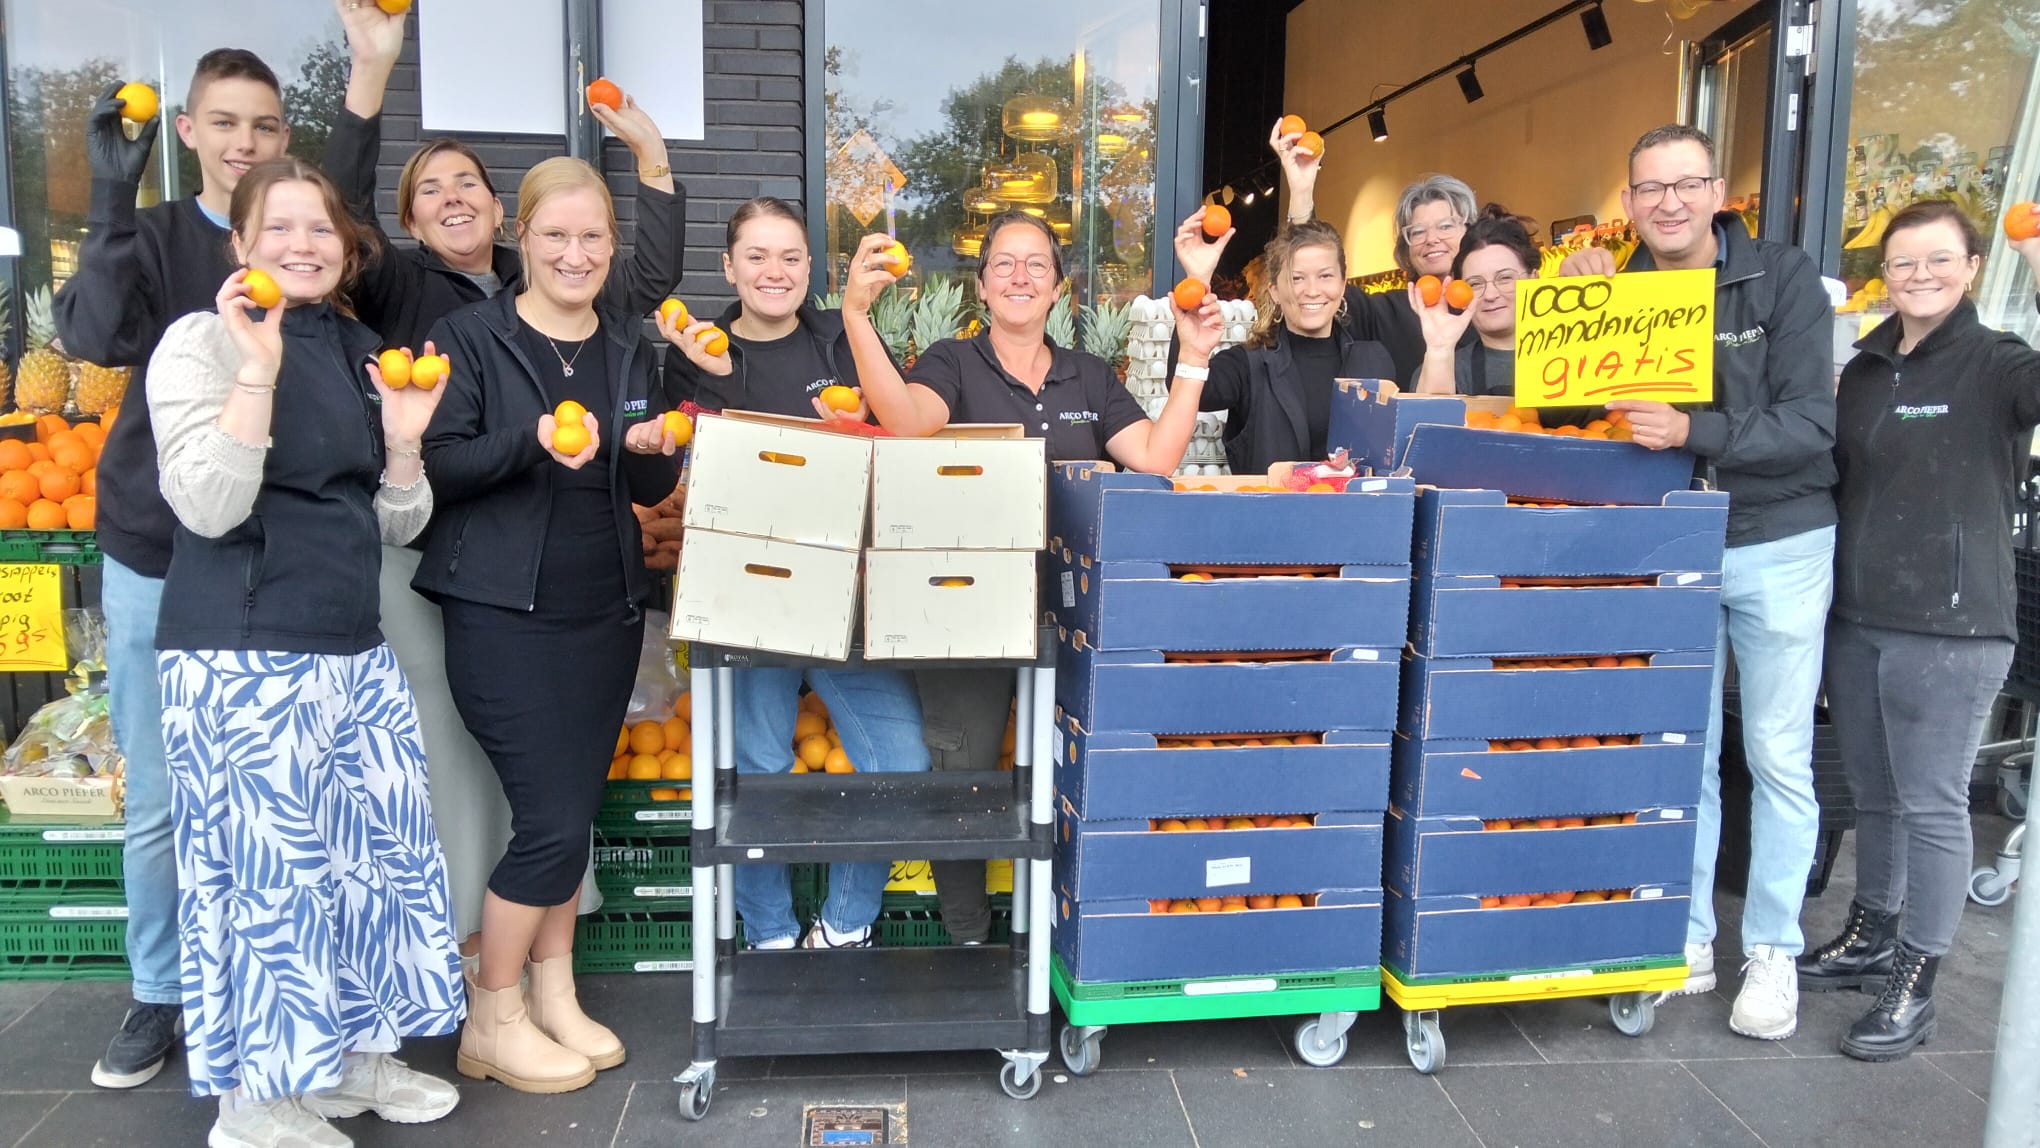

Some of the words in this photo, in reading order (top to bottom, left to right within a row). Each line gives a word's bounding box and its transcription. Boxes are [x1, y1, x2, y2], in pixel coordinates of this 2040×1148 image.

[1521, 280, 1612, 322] 1000
[806, 378, 829, 393] ARCO
[1059, 411, 1082, 421] ARCO
[1894, 405, 1921, 415] ARCO
[23, 786, 59, 798] ARCO
